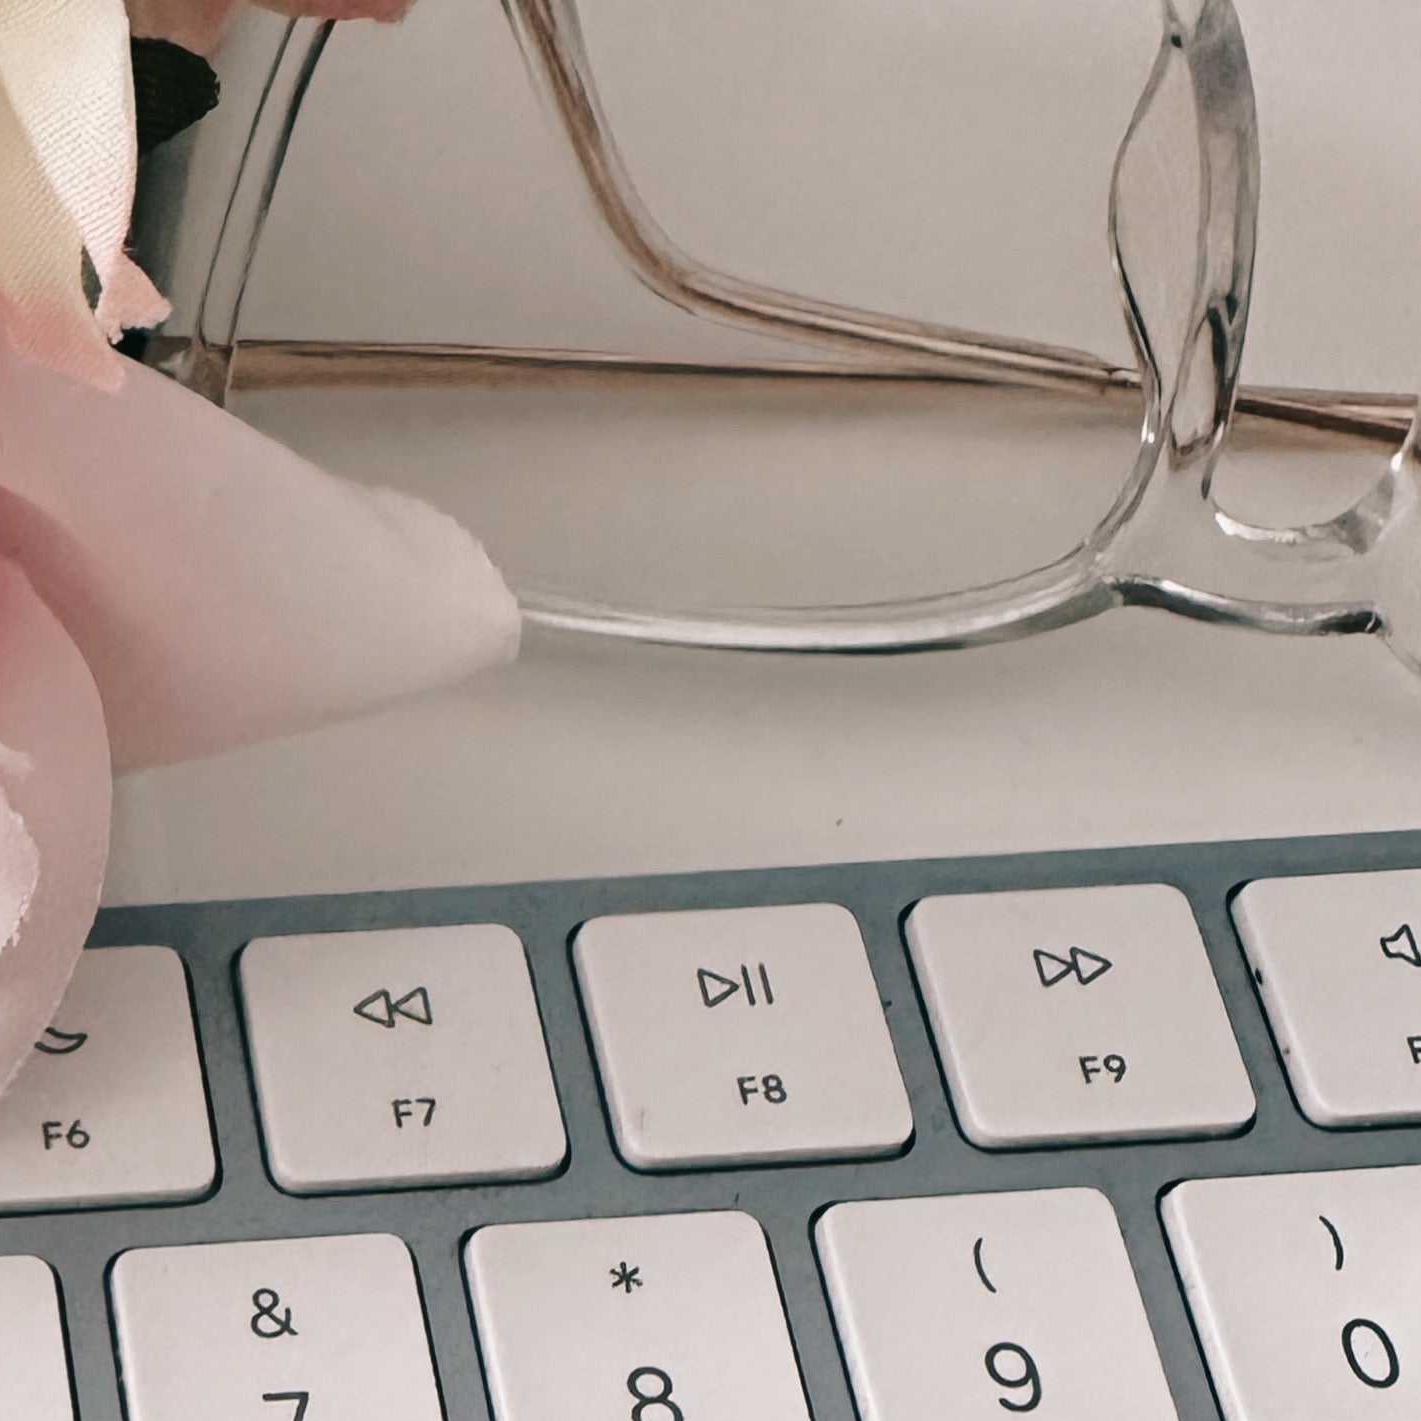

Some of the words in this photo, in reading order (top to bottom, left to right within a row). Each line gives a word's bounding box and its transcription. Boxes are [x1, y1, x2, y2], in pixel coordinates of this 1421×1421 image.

[1078, 1053, 1127, 1085] F9
[736, 1073, 788, 1106] F8
[390, 1097, 437, 1129] F7
[41, 1119, 91, 1151] F6
[250, 1287, 299, 1340] &
[1341, 1317, 1401, 1390] 0
[984, 1341, 1043, 1414] 9
